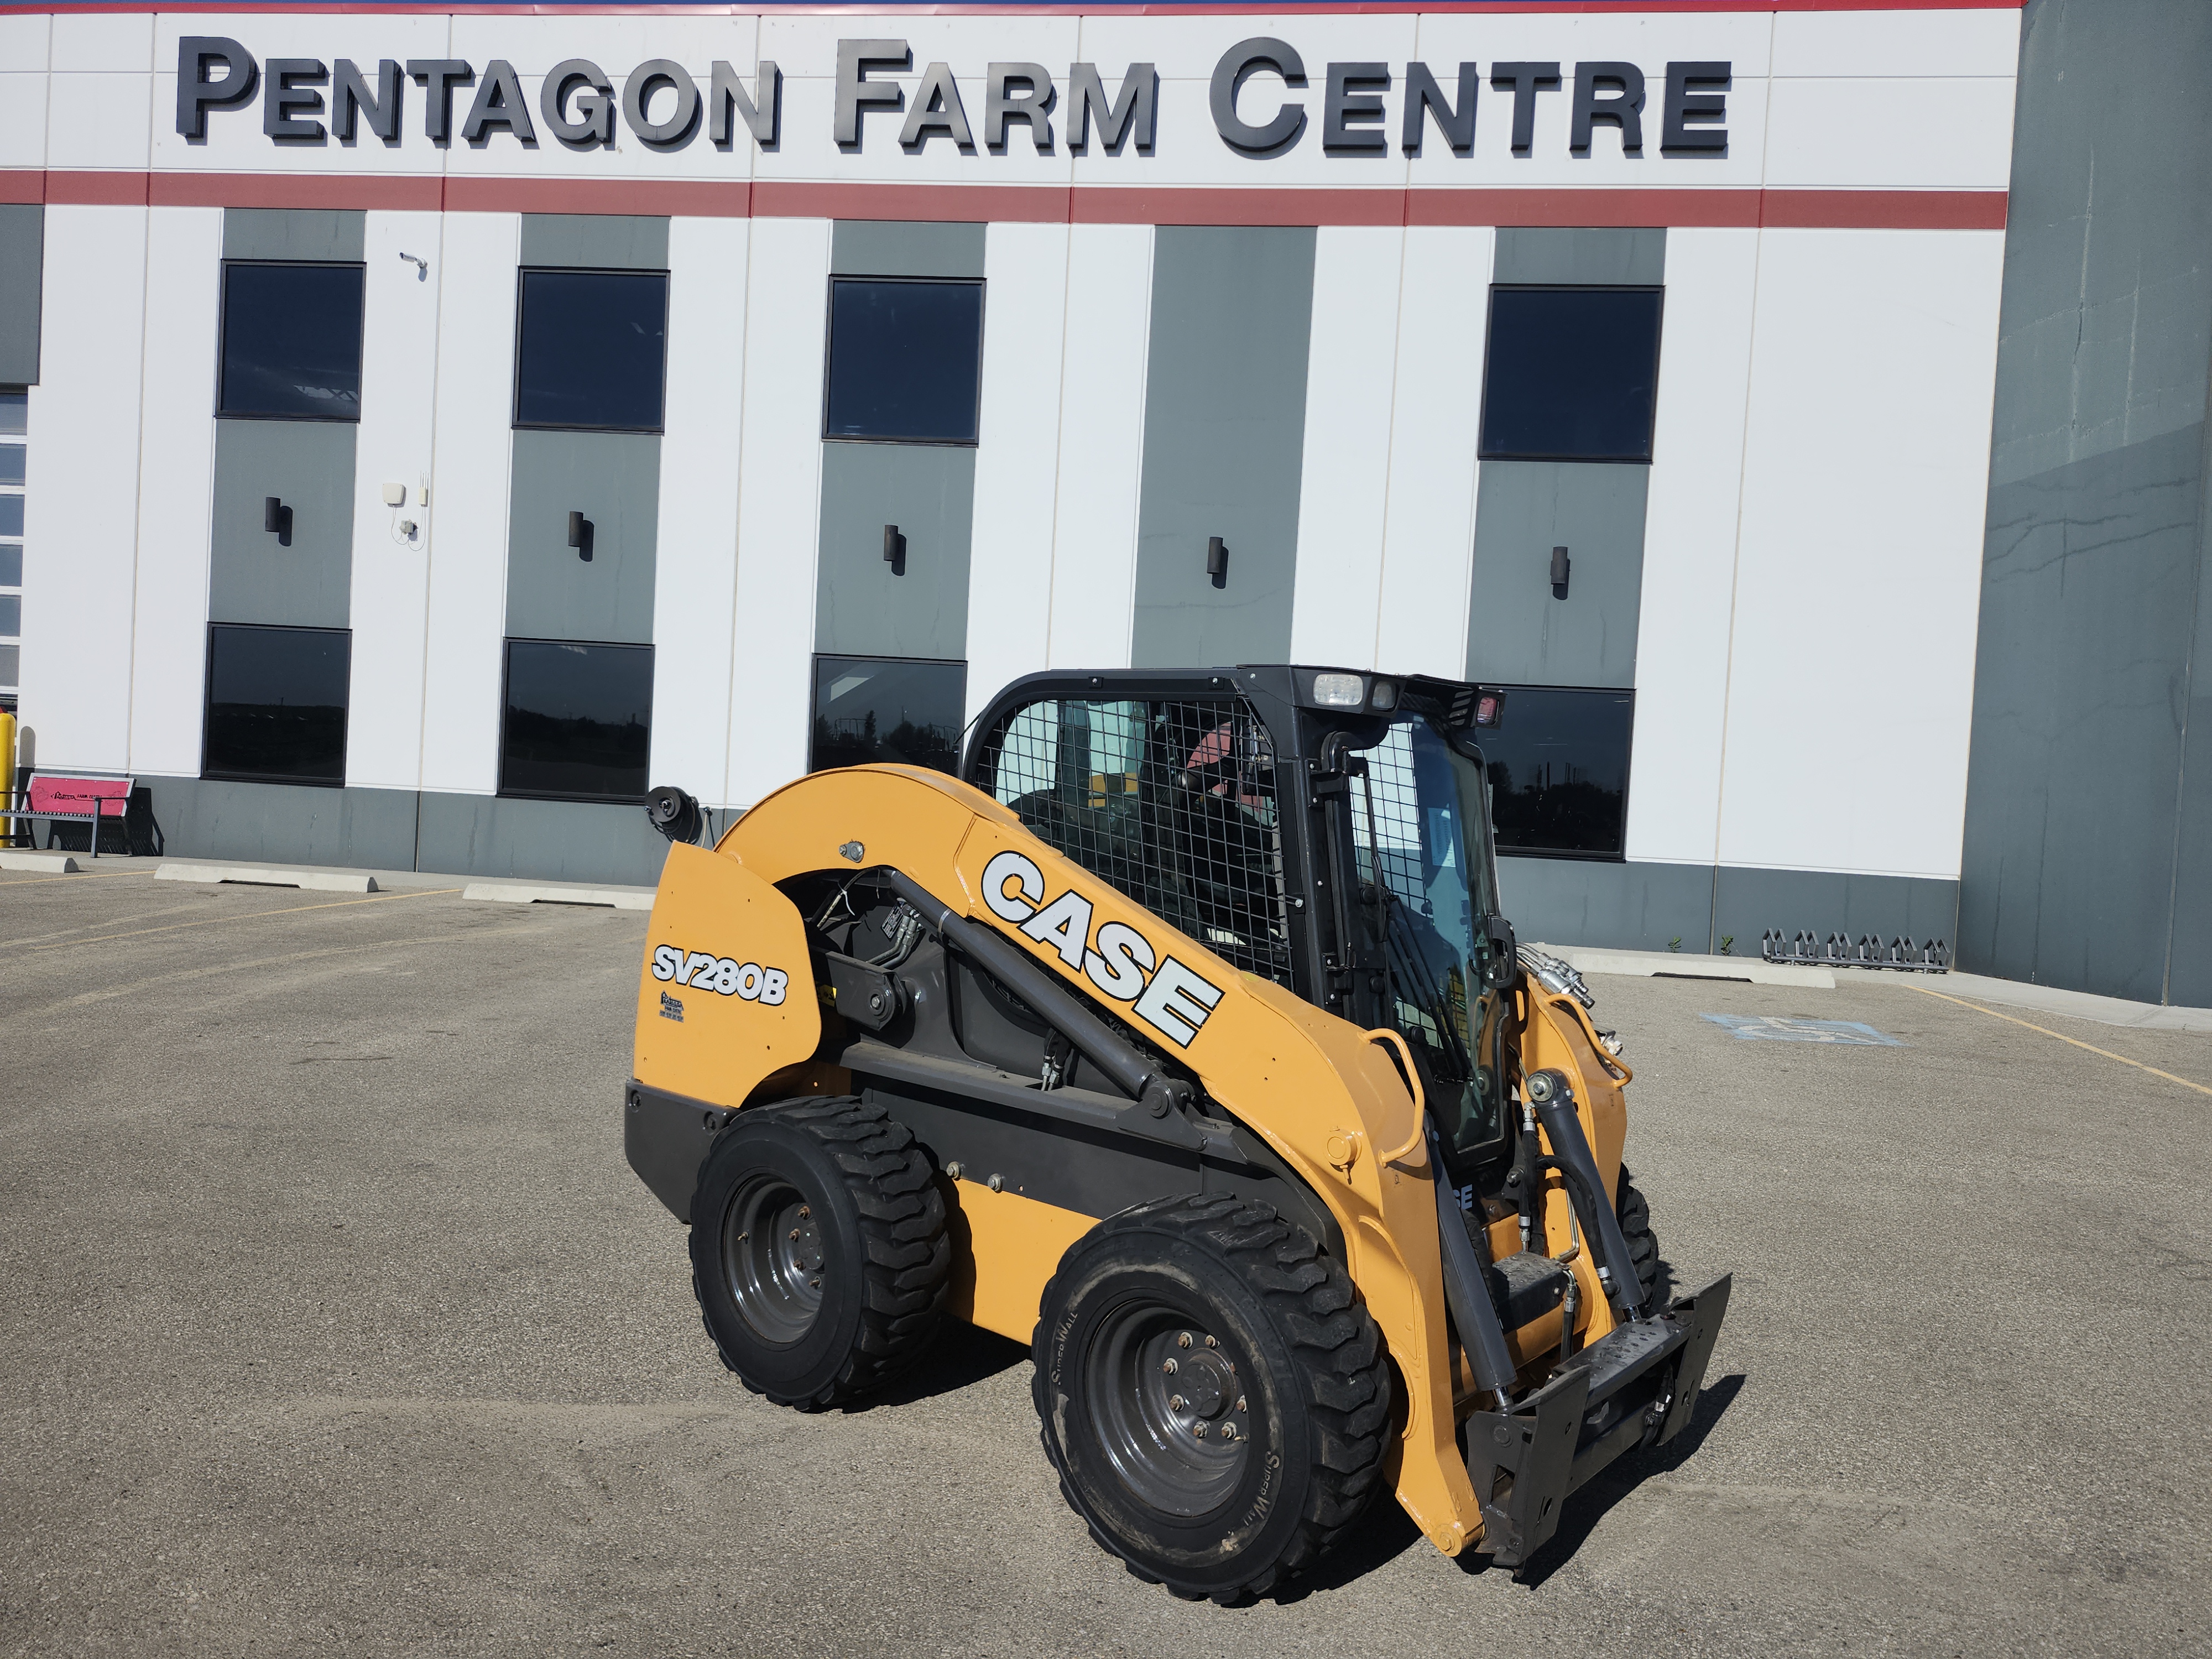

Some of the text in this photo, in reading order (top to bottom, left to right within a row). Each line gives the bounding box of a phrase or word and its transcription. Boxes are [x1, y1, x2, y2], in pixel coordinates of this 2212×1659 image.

[176, 36, 1732, 153] PENTAGON FARM CENTRE
[651, 944, 789, 1006] SV280B
[981, 850, 1226, 1050] CASE
[1453, 1184, 1473, 1209] SE
